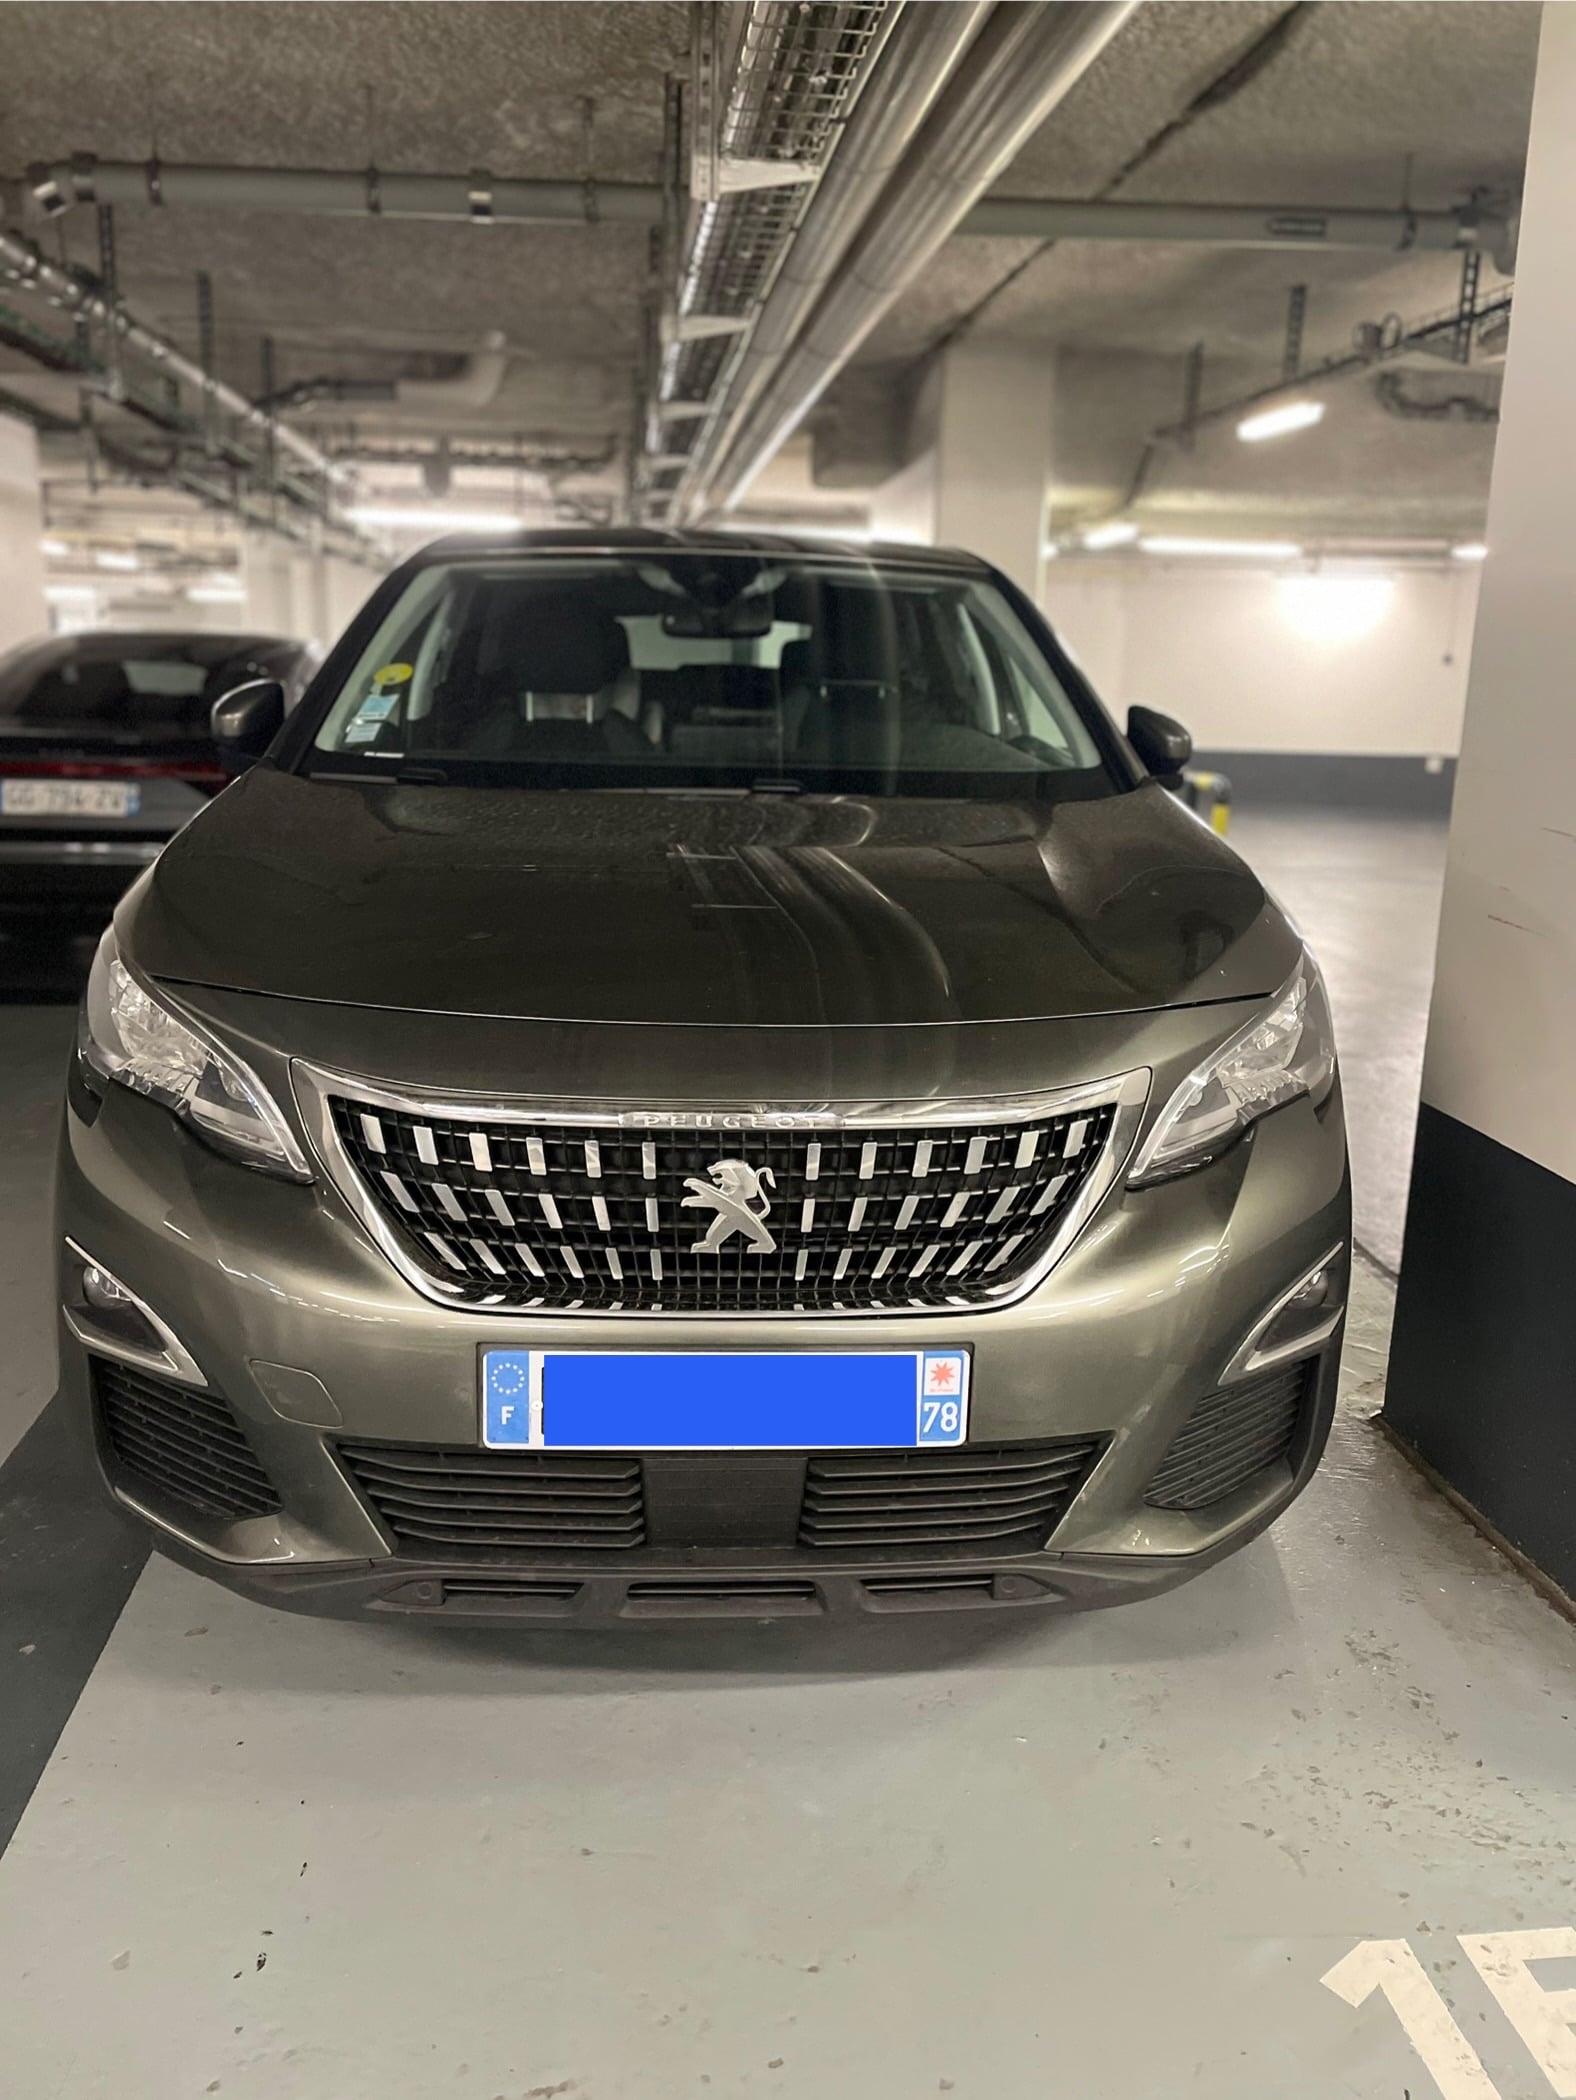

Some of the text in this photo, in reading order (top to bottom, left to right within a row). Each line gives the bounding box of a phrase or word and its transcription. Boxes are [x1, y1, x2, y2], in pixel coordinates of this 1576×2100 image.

[641, 1114, 820, 1128] PEUGEOT
[501, 1406, 514, 1425] F
[923, 1401, 959, 1433] 78
